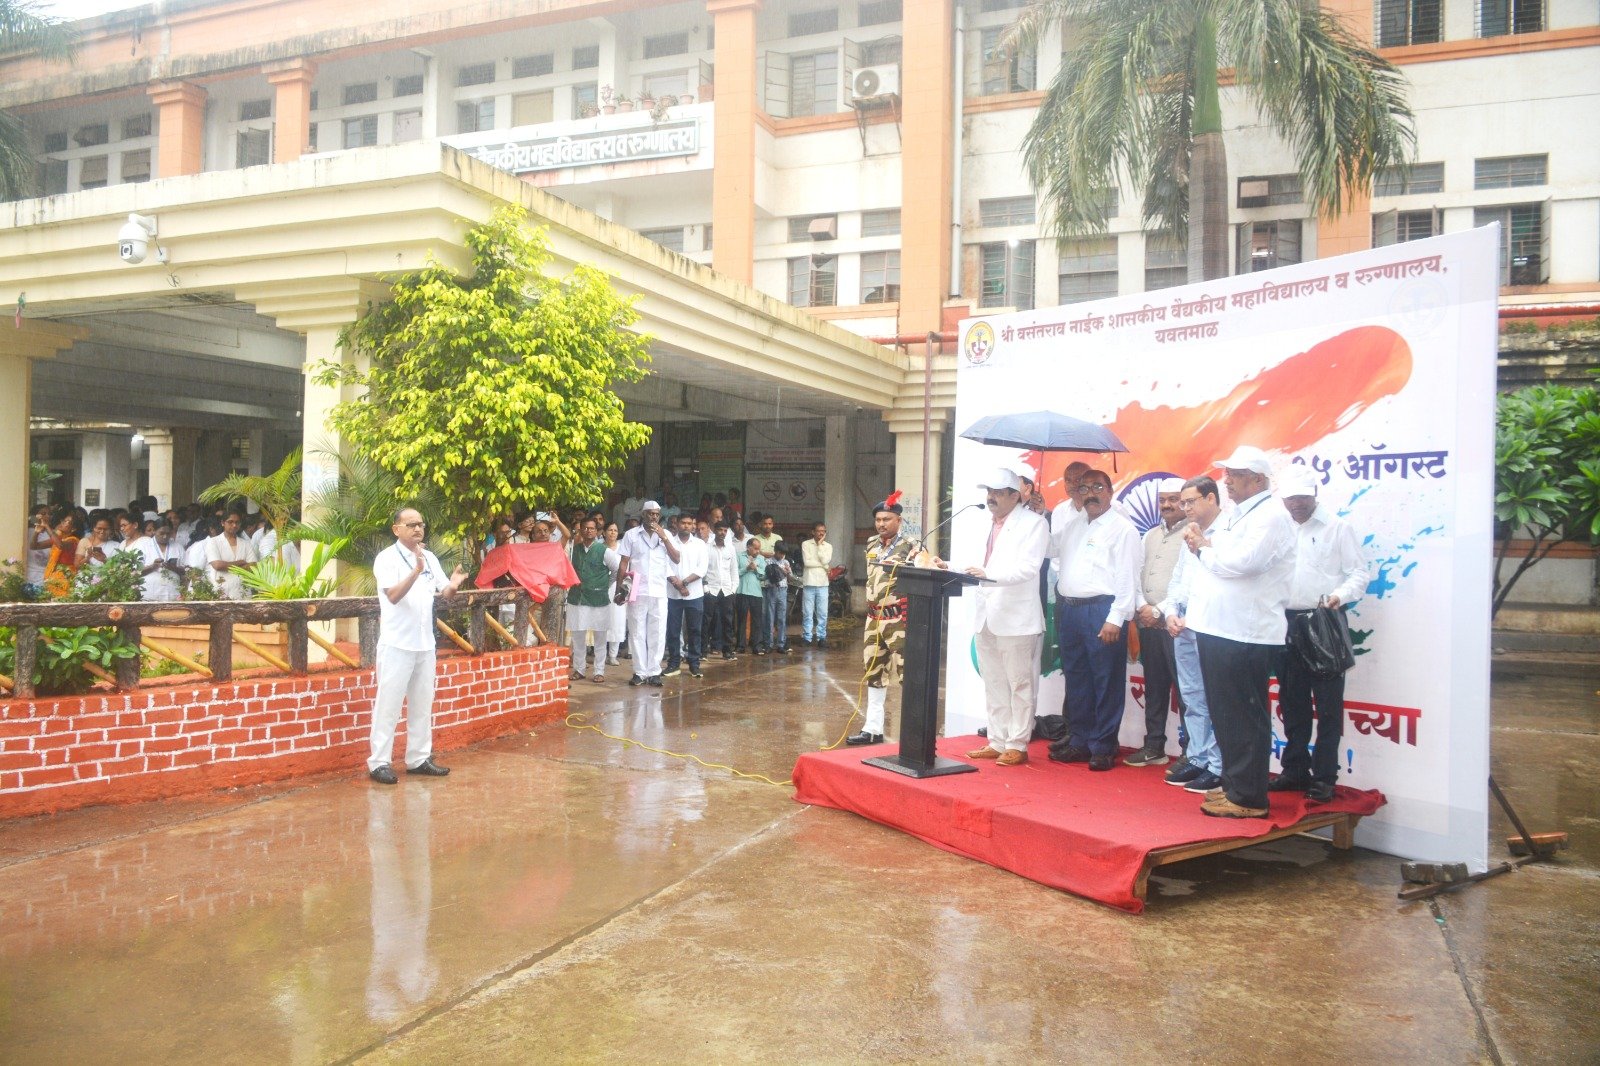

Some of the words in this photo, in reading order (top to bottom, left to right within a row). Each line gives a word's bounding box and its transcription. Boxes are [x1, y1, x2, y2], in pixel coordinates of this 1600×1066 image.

[628, 126, 695, 155] रुग्णालय
[1001, 325, 1015, 343] श्री
[1017, 321, 1066, 339] वसंतराव
[1069, 312, 1105, 335] नाईक
[1109, 304, 1167, 329] शासकीय
[1171, 294, 1228, 318] वैद्यकीय
[1231, 276, 1330, 310] महाविद्यालय
[1335, 272, 1350, 289] व
[1355, 254, 1449, 286] रुग्णालय,
[1155, 321, 1220, 344] यवतमाळ
[1343, 443, 1449, 480] ऑगस्ट
